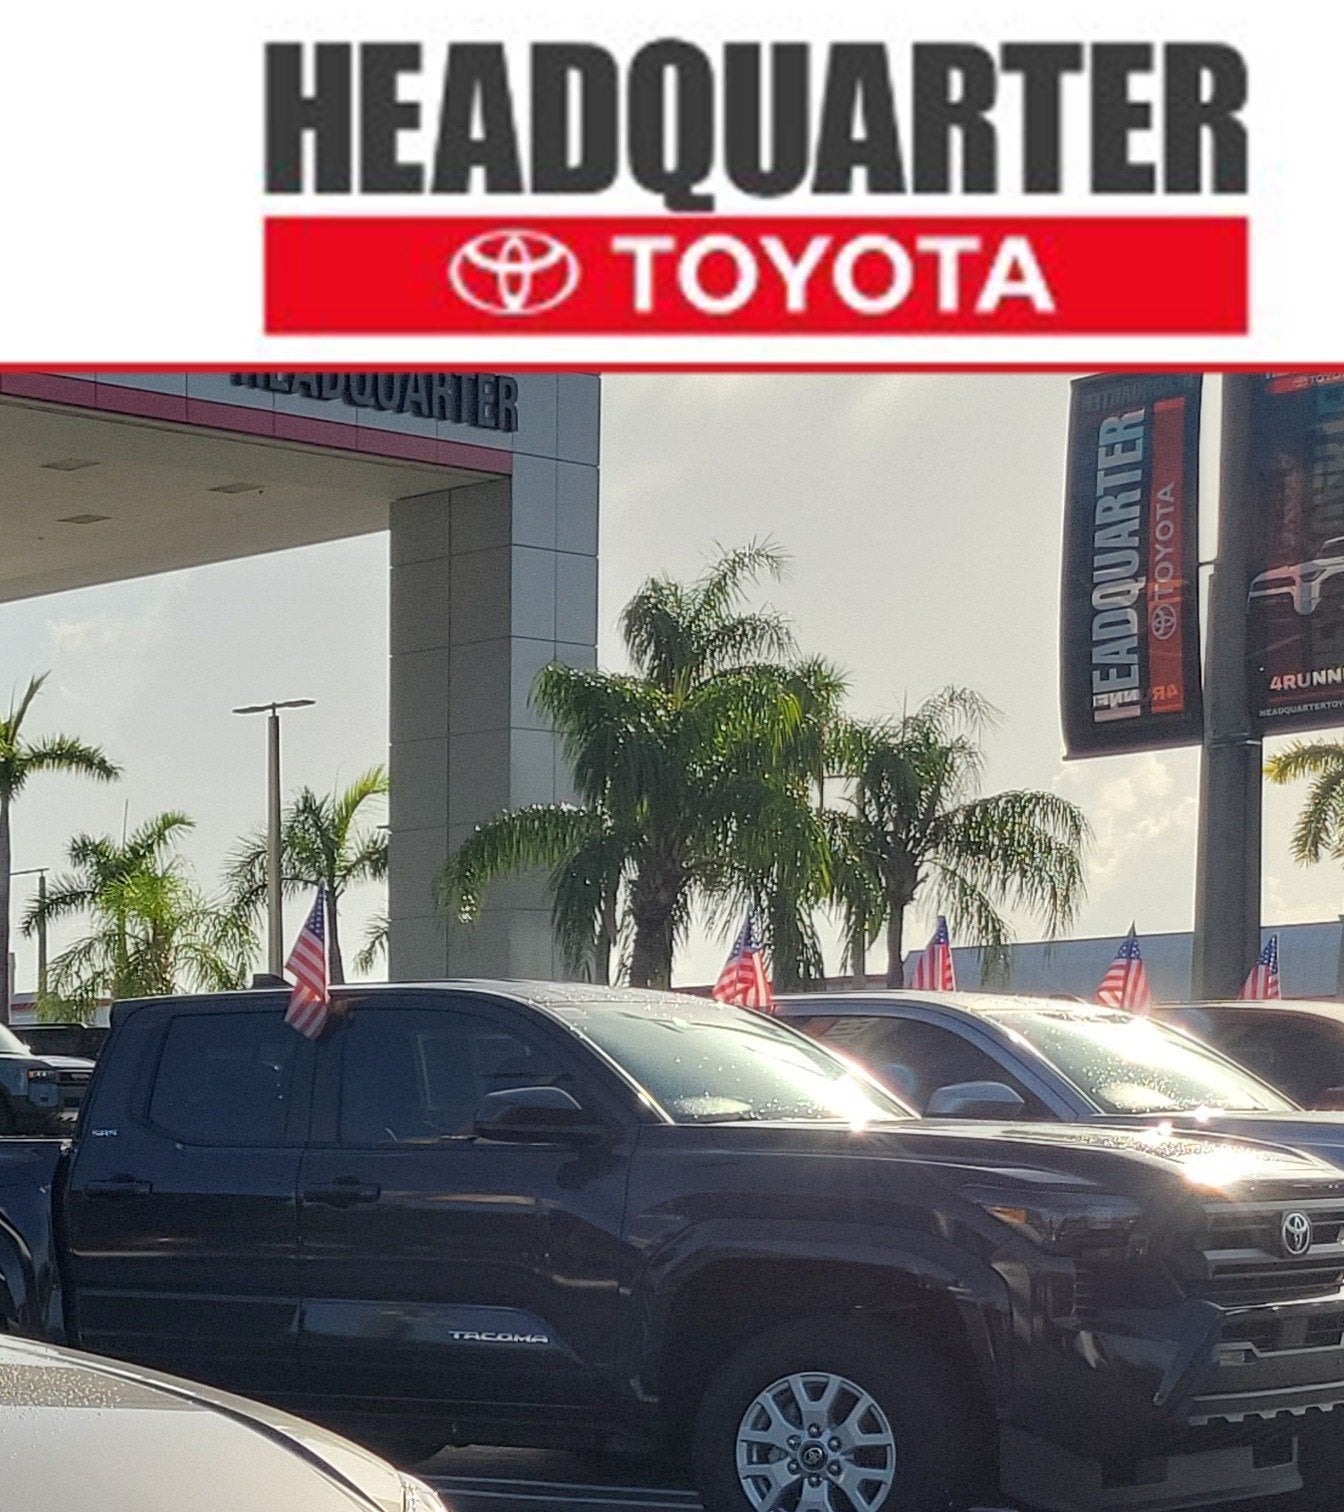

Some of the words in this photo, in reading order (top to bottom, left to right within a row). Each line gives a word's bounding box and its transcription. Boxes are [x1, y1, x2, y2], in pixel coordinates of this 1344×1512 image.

[230, 373, 519, 432] QUARTER
[1091, 407, 1147, 723] HEADQUARTER
[1155, 482, 1175, 601] TOYOTA
[1270, 667, 1344, 691] 4RUNN
[448, 1330, 549, 1344] TACOMA
